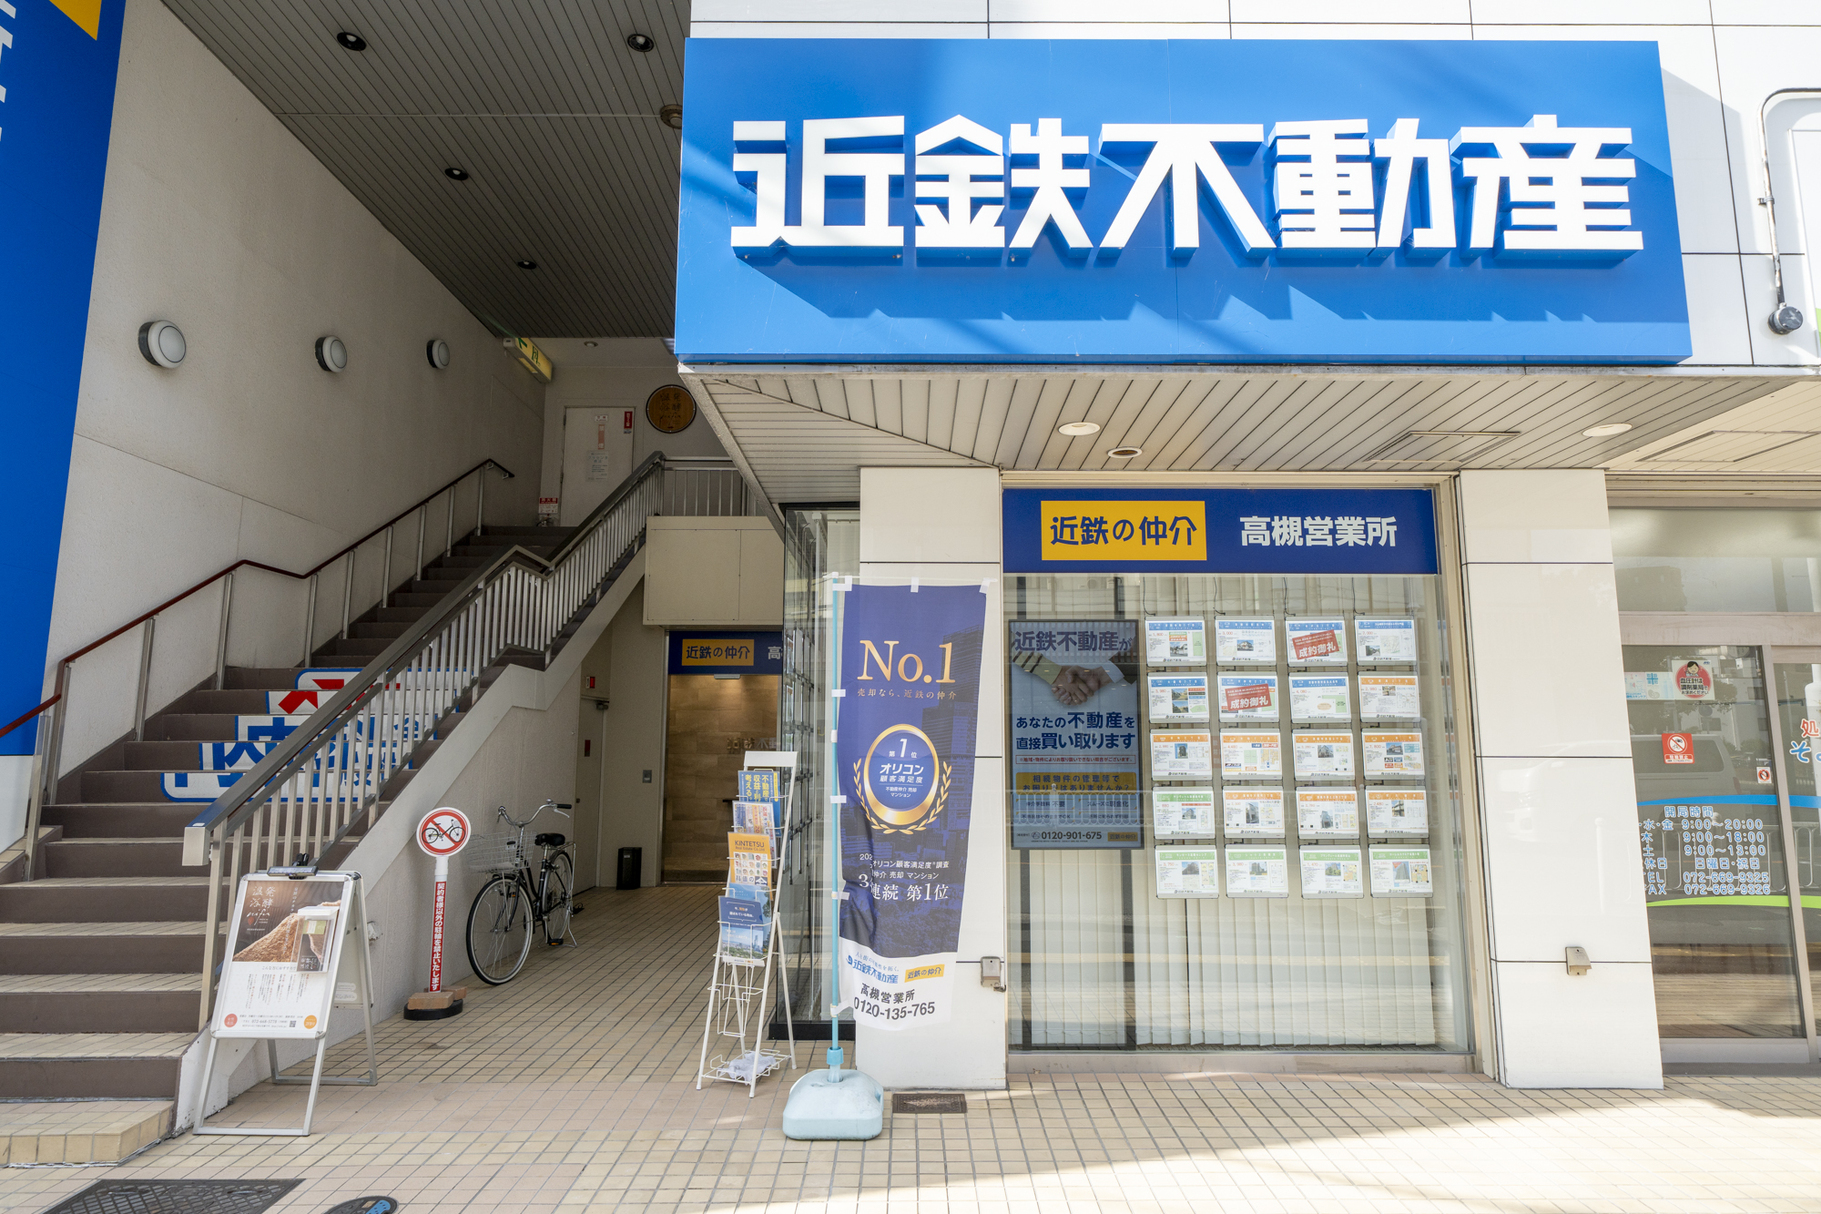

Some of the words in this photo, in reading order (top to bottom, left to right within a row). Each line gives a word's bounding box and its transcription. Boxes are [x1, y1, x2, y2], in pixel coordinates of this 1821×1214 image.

[731, 114, 1645, 252] 近鉄不動産
[1050, 515, 1198, 546] 近鉄の仲介
[1239, 515, 1398, 547] 高槻営業所
[1015, 630, 1133, 652] 近鉄不動産が
[686, 645, 750, 660] 近鉄の仲介
[767, 646, 782, 660] 高
[1298, 641, 1337, 659] 成約御礼
[857, 639, 956, 684] No.1
[857, 688, 956, 700] 売却なら、近鉄の仲介
[1230, 694, 1269, 709] 成約御礼
[1016, 711, 1136, 729] あなたの不動産を
[1016, 732, 1136, 750] 直接買い取ります
[879, 763, 925, 776] オリコン
[879, 775, 924, 784] 顧客満足度
[1664, 806, 1714, 818] 開局時間
[1041, 831, 1102, 840] 0120-901-675
[734, 840, 765, 848] KINTETSU
[1642, 857, 1668, 870] 休日
[906, 872, 940, 880] マンション
[1642, 871, 1665, 883] EL
[1682, 871, 1770, 884] 072-669-9325
[858, 873, 899, 901] 3連続
[906, 882, 949, 902] 第1位
[1684, 883, 1771, 895] 072-669-9326
[852, 959, 899, 984] 近鉄不動産
[907, 966, 942, 980] 近鉄の仲介
[860, 982, 915, 1005] 高槻営業所
[853, 996, 936, 1021] 0120-135-765
